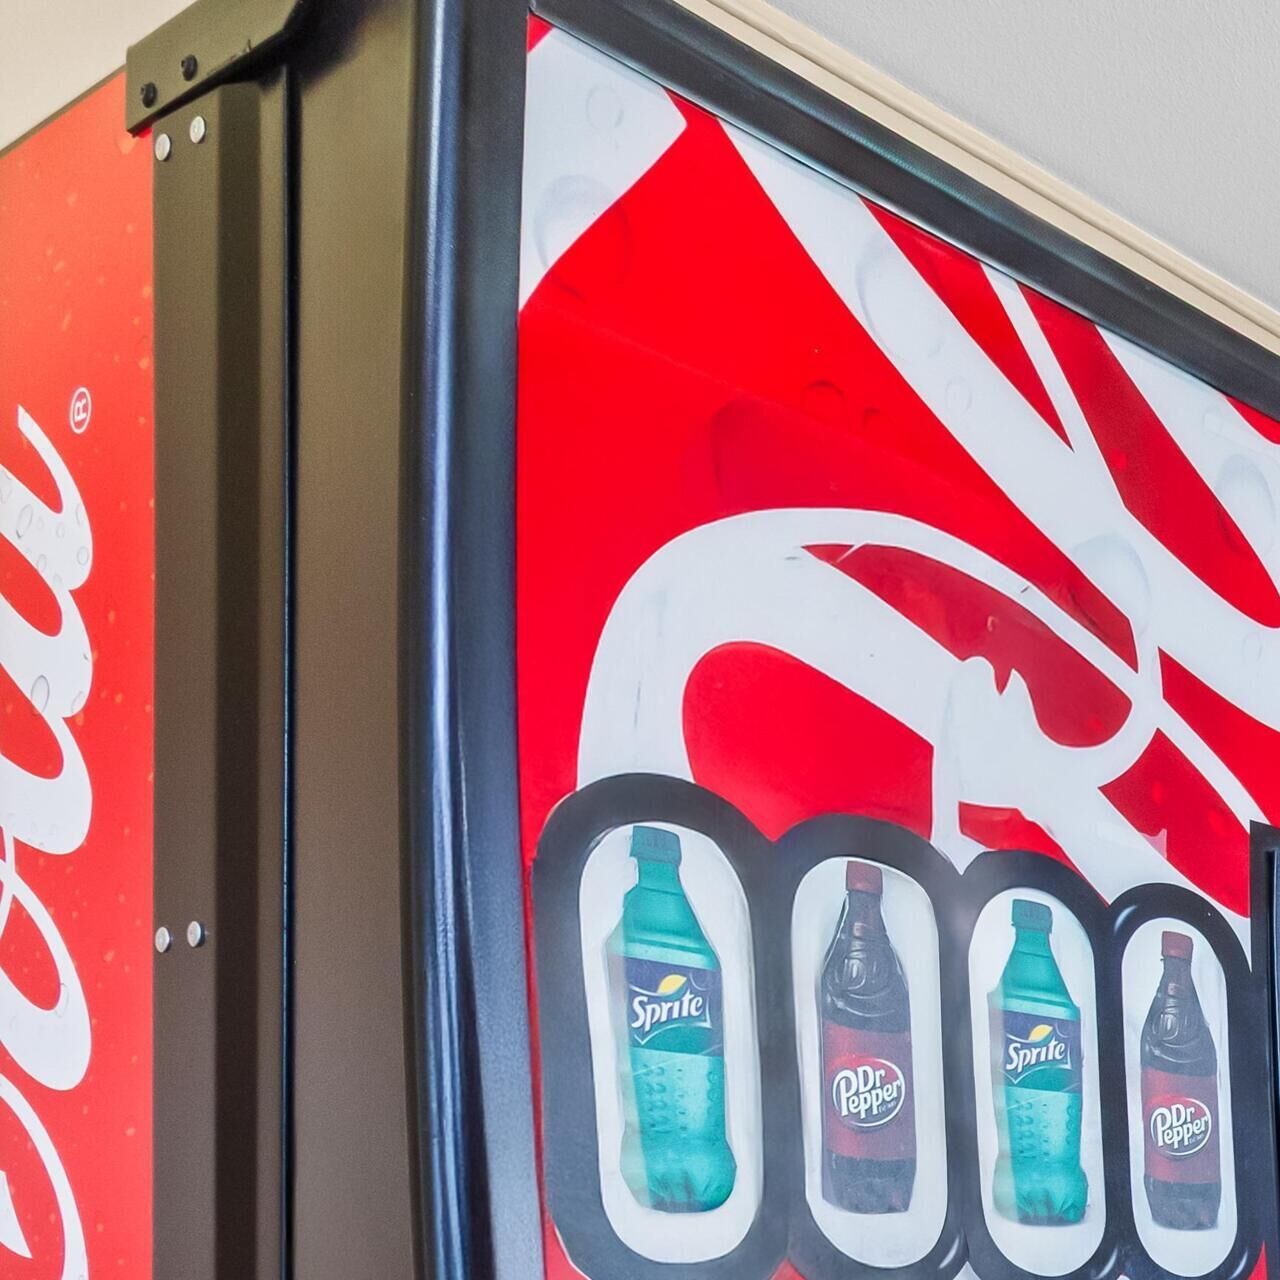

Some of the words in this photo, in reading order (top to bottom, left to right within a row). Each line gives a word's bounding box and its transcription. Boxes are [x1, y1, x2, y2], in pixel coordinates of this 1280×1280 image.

[631, 988, 703, 1032] Sprite
[1005, 1035, 1065, 1073] Sprite
[833, 1069, 901, 1119] Pepper
[856, 1065, 886, 1094] Dr
[1151, 1107, 1208, 1149] Pepper
[1171, 1104, 1195, 1127] Dr
